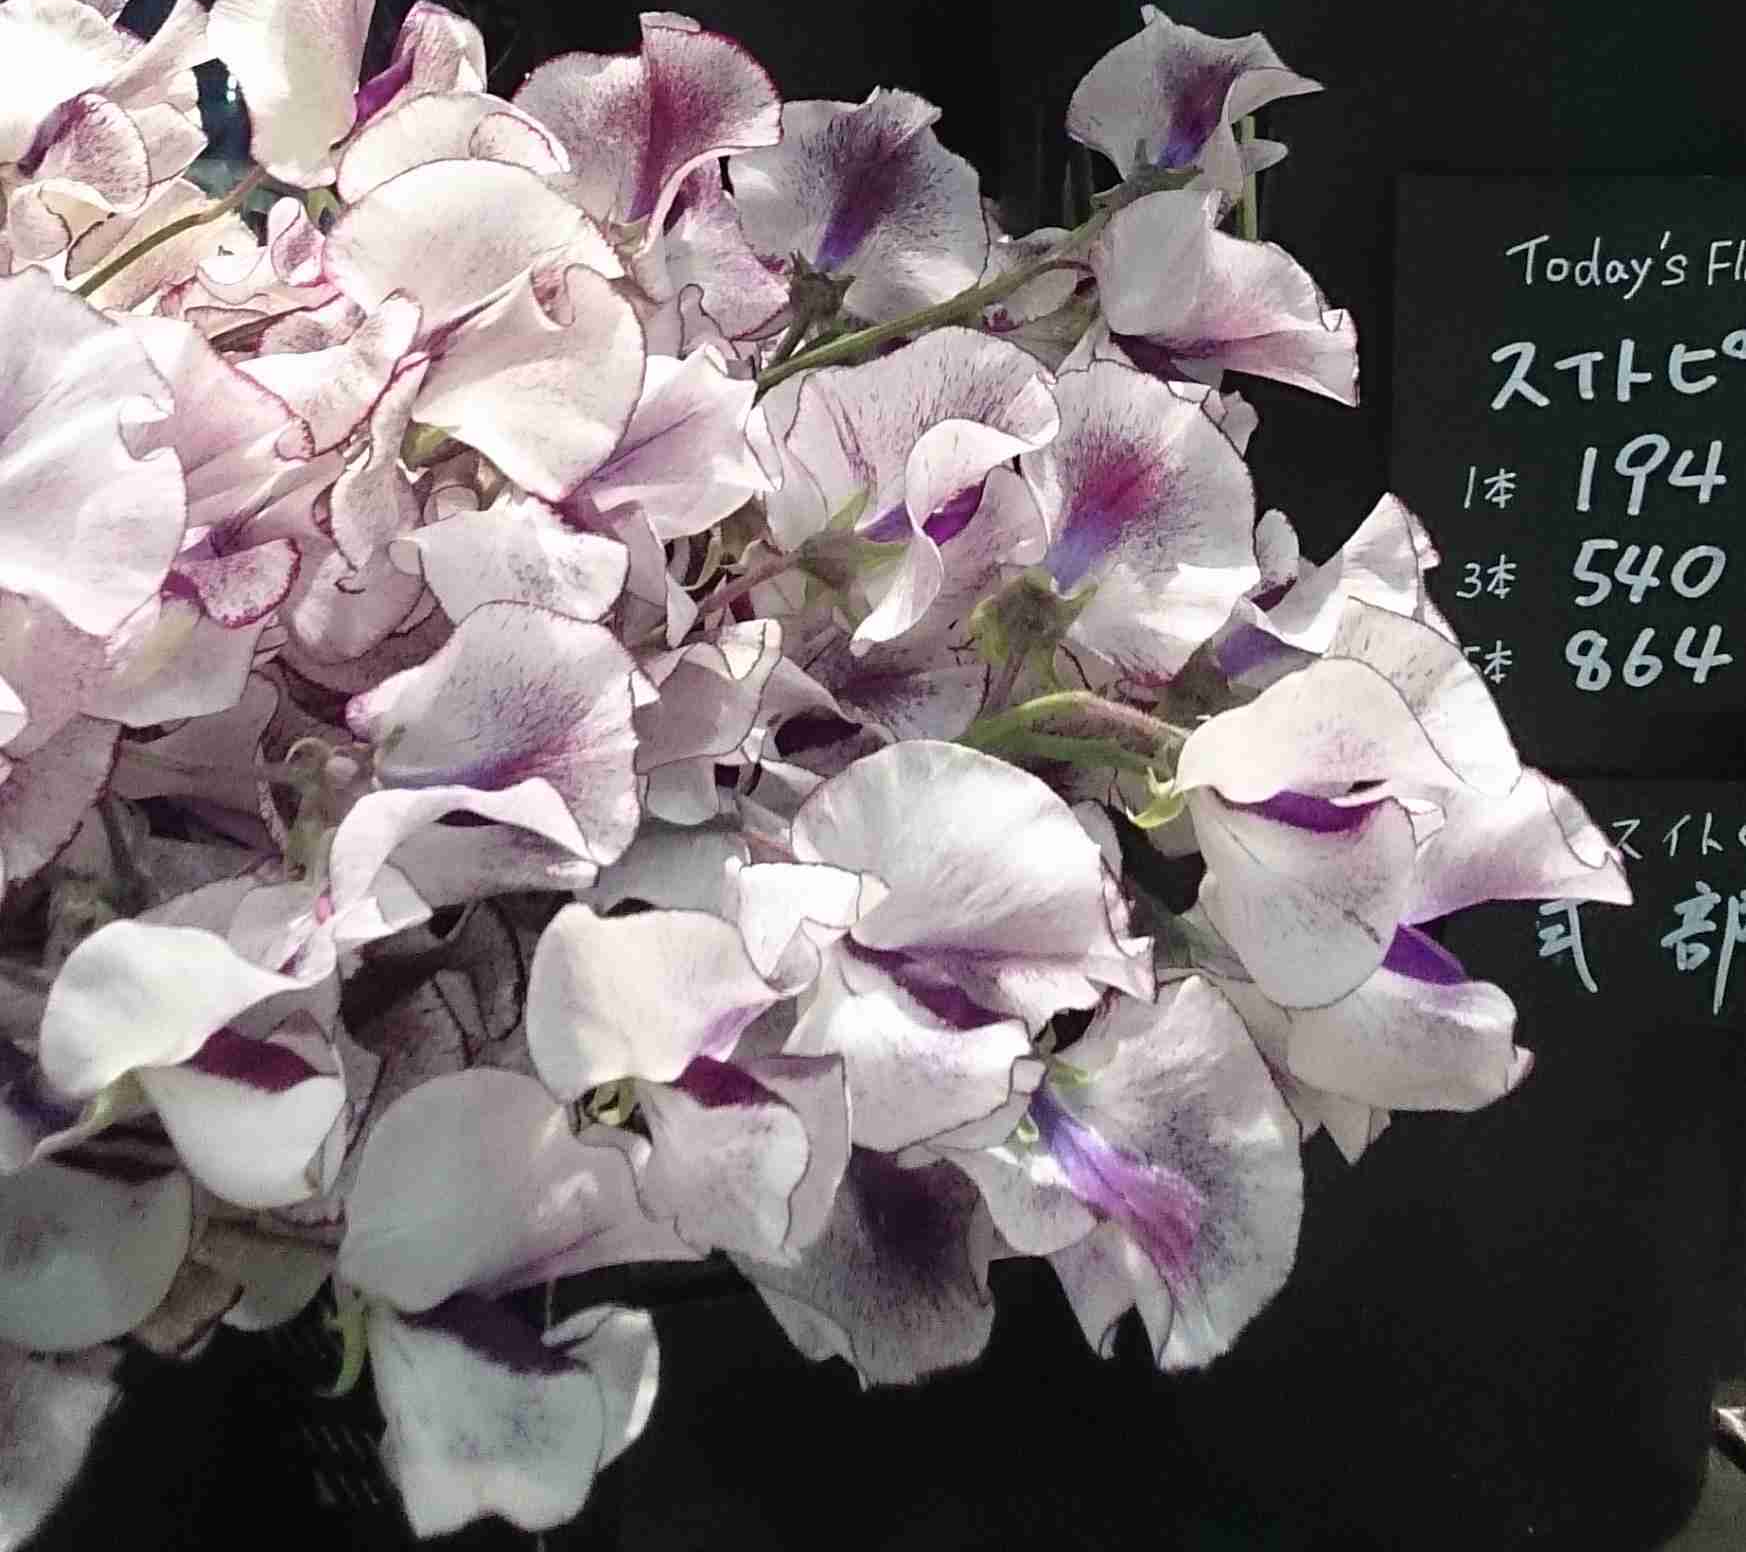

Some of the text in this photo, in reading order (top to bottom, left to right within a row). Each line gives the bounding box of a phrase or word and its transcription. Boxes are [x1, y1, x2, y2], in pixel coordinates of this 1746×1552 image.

[1506, 231, 1746, 299] Today's Fl
[1463, 433, 1728, 516] 1本 194
[1456, 539, 1727, 606] 3本 540
[1565, 624, 1733, 692] 864
